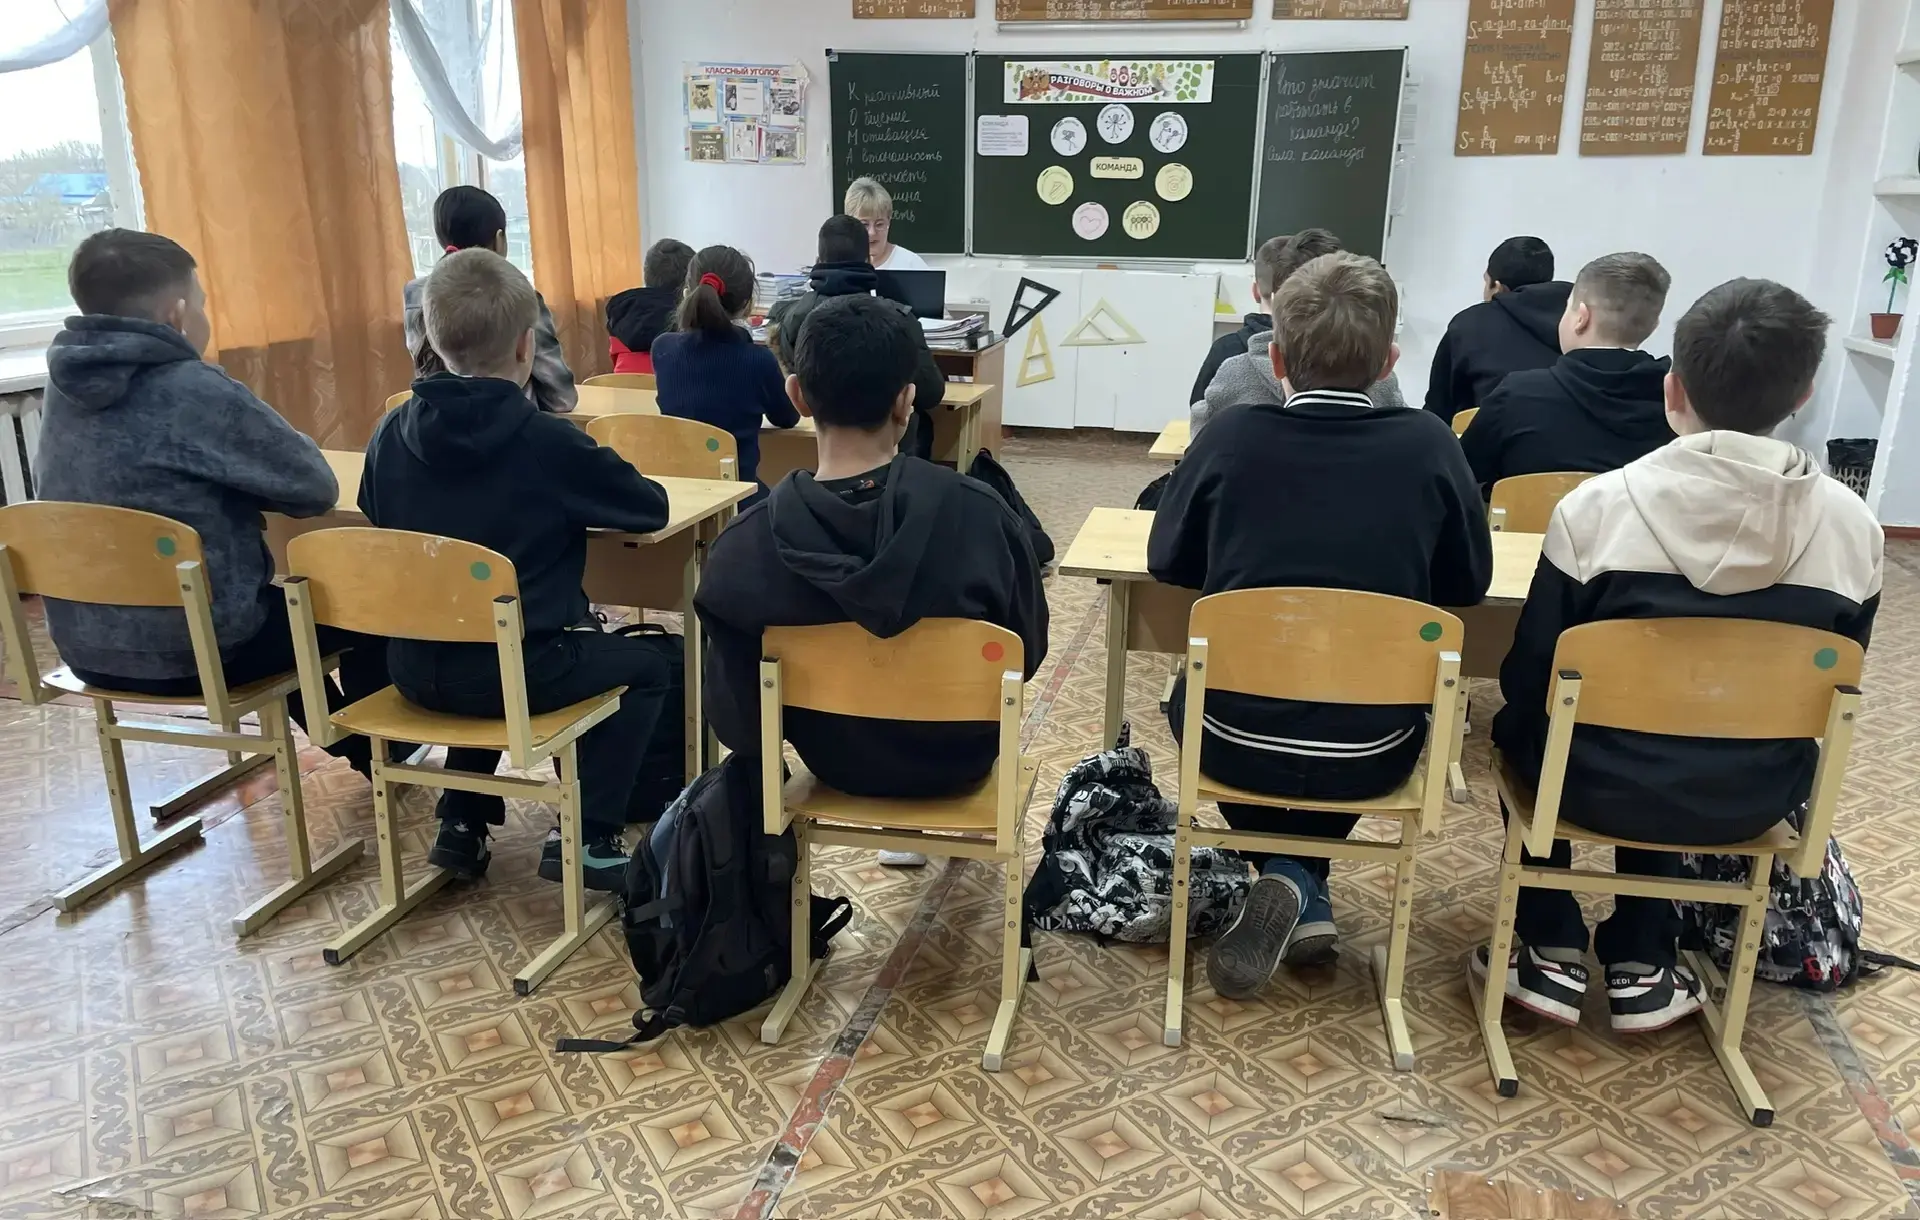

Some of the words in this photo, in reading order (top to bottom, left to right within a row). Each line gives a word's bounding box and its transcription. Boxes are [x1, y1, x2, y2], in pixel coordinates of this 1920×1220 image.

[704, 67, 748, 76] КЛАССНЫЙ
[750, 67, 780, 76] УГОЛОК
[1050, 75, 1105, 92] РАЗГОВОРЫ
[1105, 86, 1112, 94] О
[1112, 86, 1153, 97] ВАЖНОМ
[1095, 163, 1138, 172] КОМАНДА
